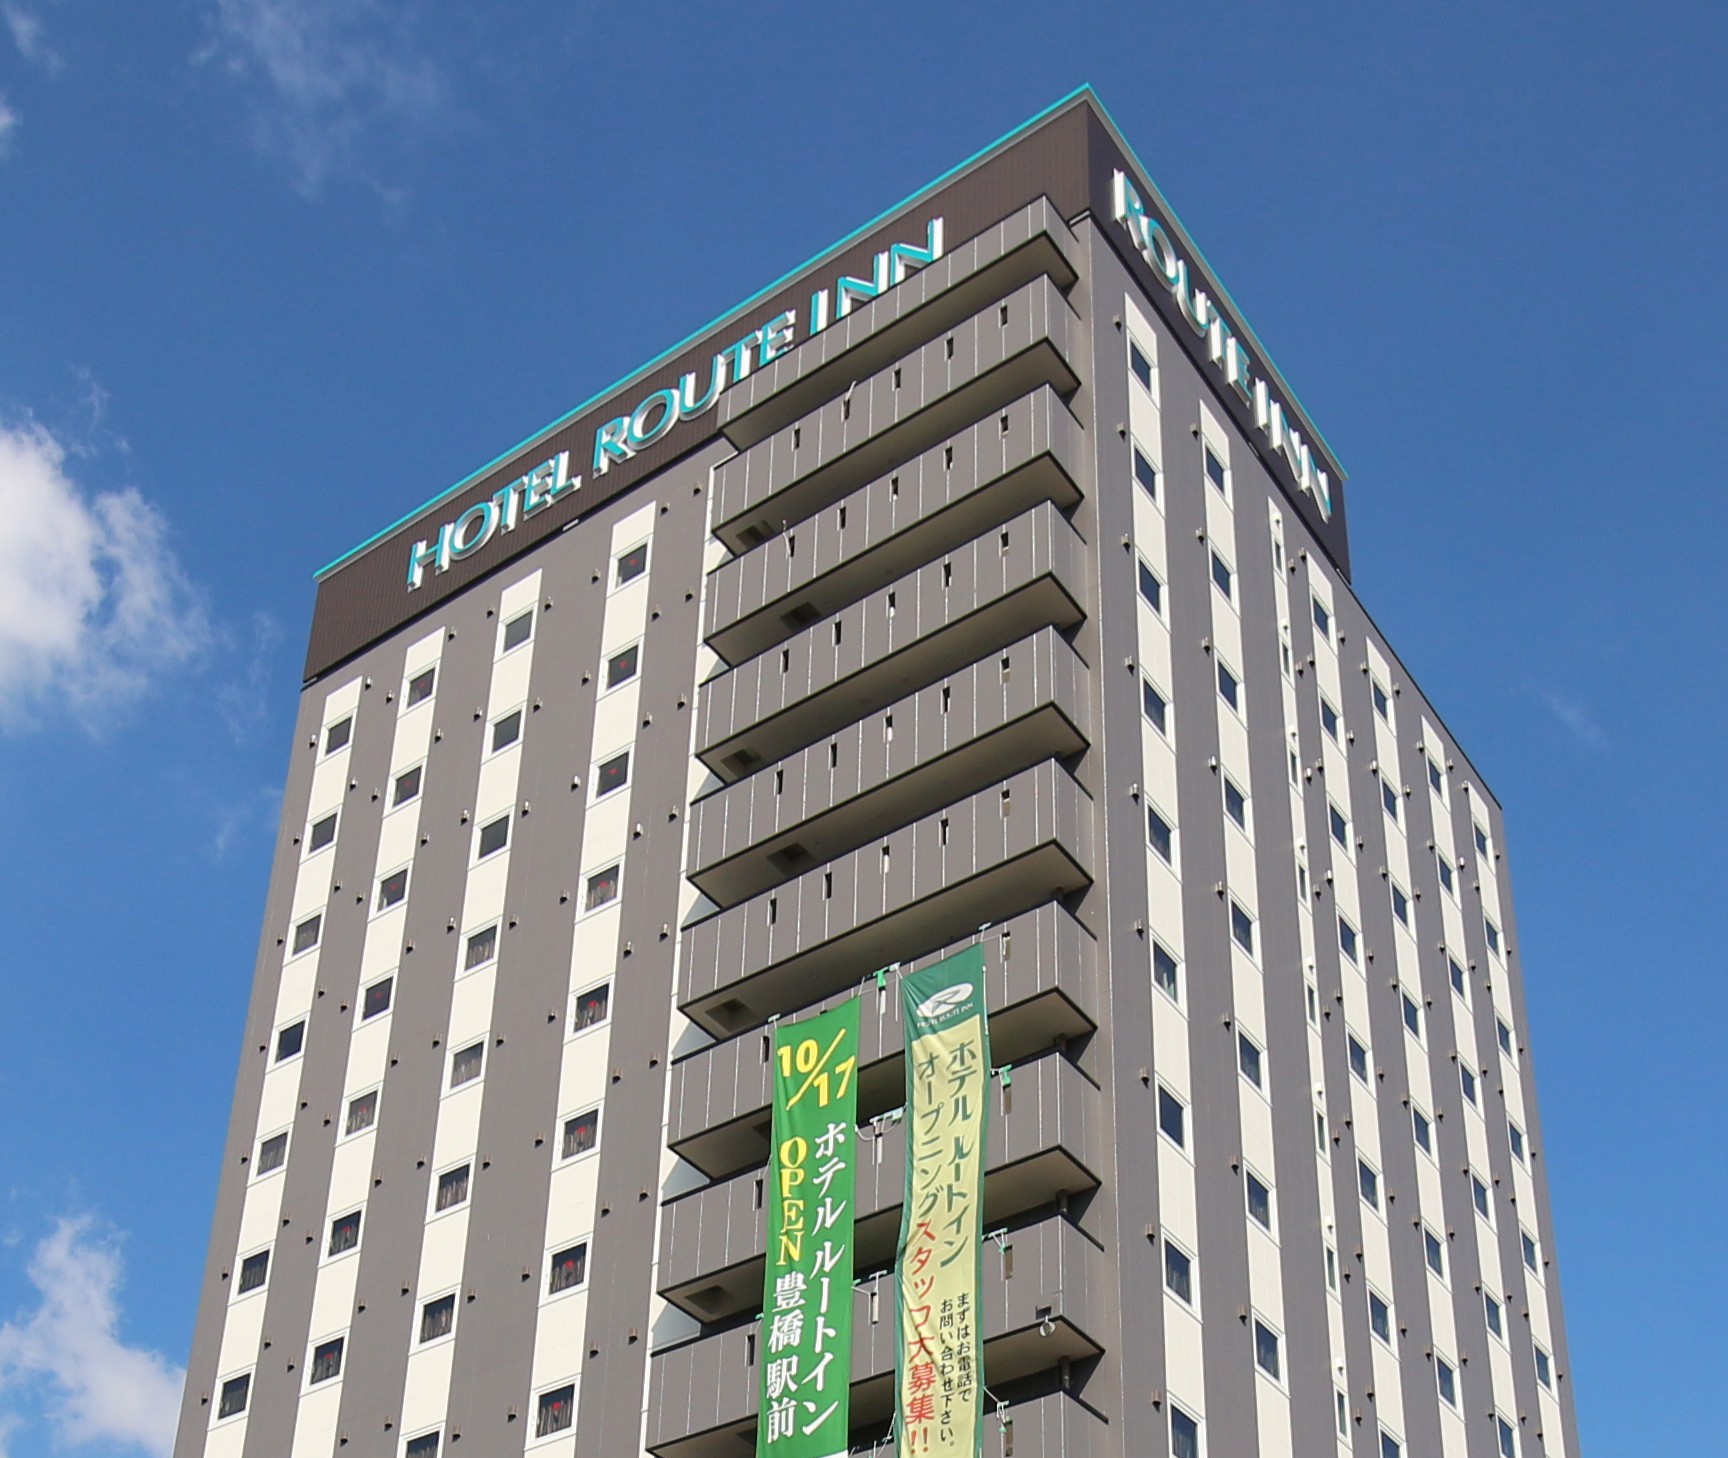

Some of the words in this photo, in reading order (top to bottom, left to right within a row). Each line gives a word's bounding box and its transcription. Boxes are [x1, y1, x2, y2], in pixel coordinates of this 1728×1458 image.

[406, 450, 582, 593] HOTEL
[592, 308, 796, 479] ROUTE
[809, 216, 944, 336] INN
[1112, 167, 1252, 409] ROUTE
[1253, 376, 1332, 524] INN
[776, 1028, 856, 1111] 10/17
[776, 1136, 807, 1266] OPEN
[766, 1270, 808, 1444] 豊橋駅前
[957, 1291, 972, 1402] まずはお電話で
